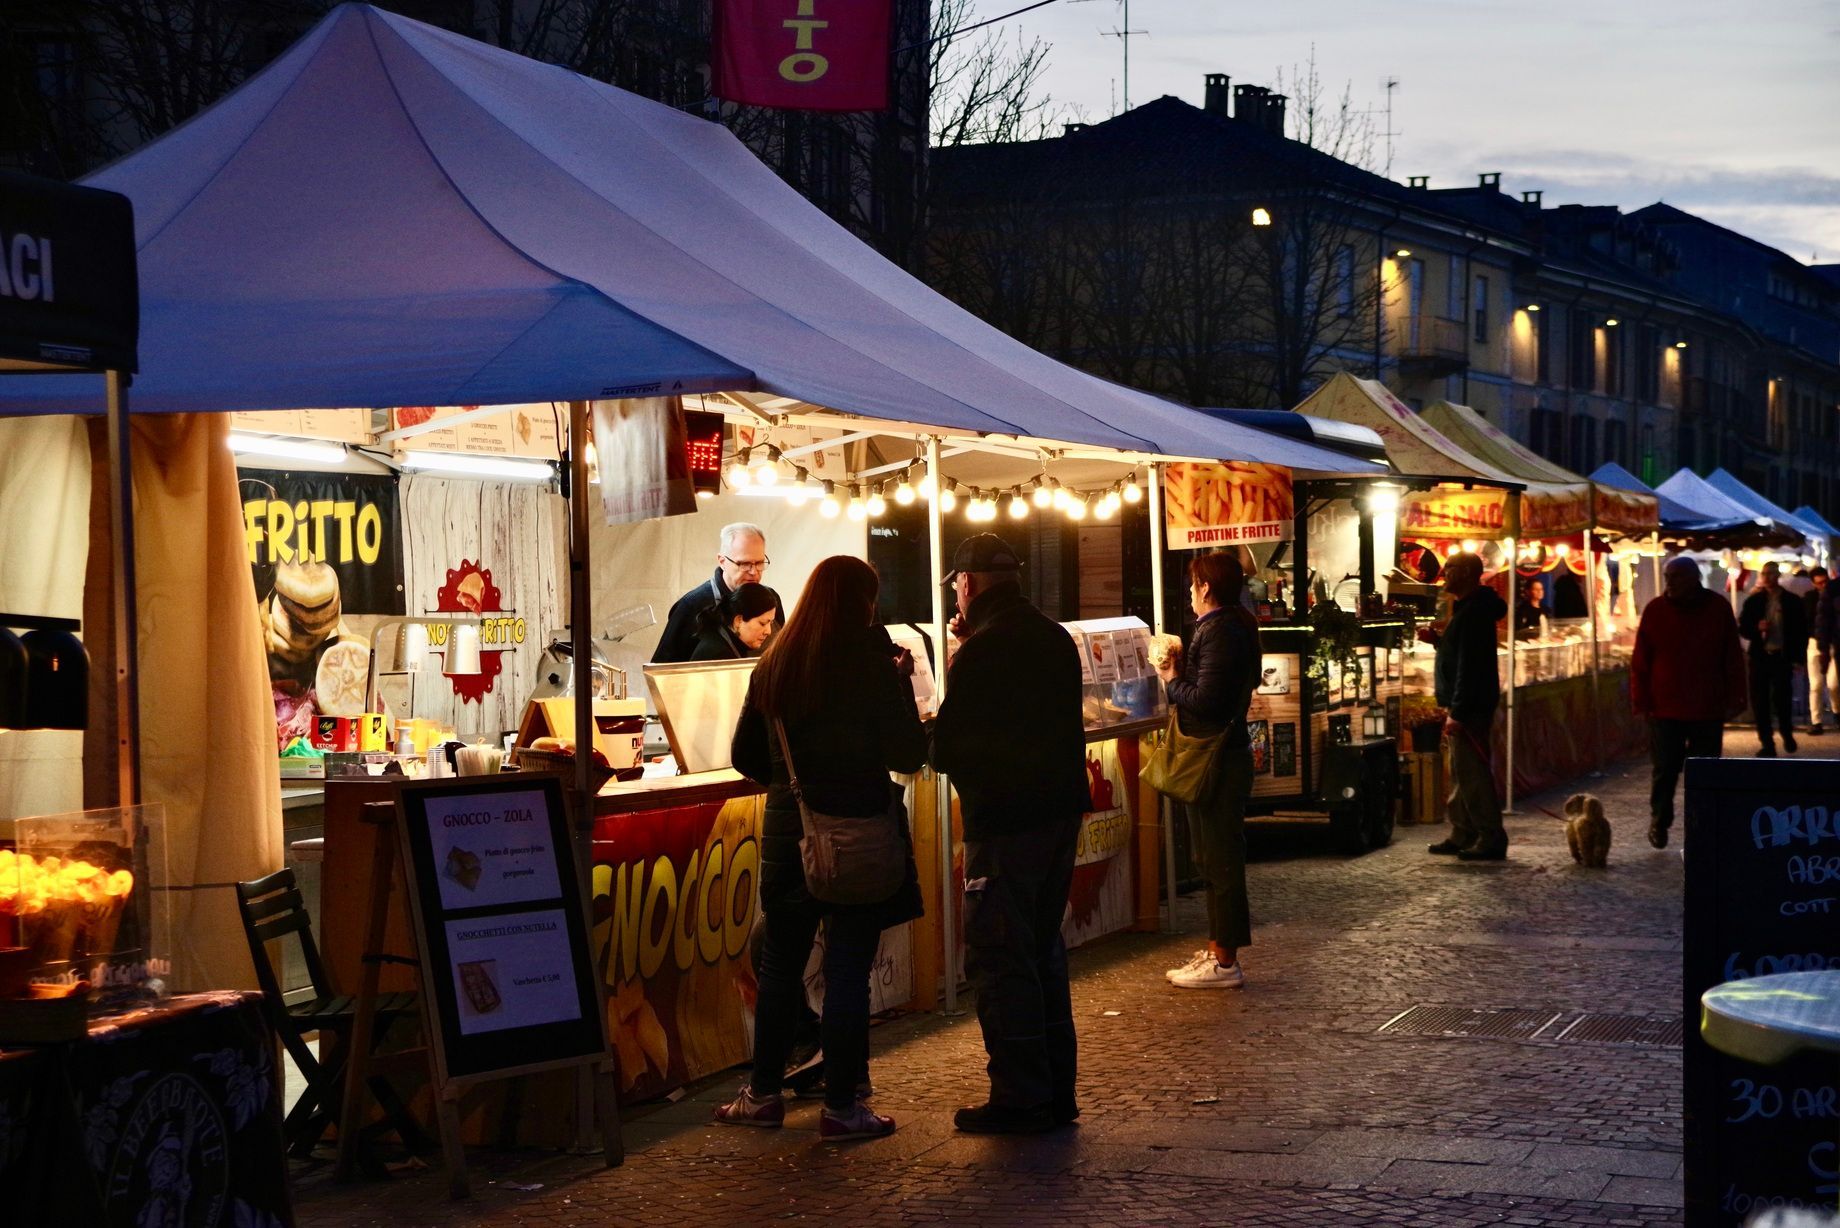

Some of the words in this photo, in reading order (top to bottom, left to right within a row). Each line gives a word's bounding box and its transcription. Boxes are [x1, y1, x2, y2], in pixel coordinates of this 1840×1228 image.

[599, 384, 662, 396] MASTERTENT
[1187, 527, 1239, 543] PATATINE
[1242, 523, 1281, 539] FRITTE
[443, 811, 491, 828] GNOCCO
[504, 808, 533, 823] ZOLA
[456, 926, 506, 940] GNOCCHETTI
[507, 925, 522, 936] CON
[523, 921, 558, 934] NUTELLA
[1725, 1077, 1784, 1123] 30
